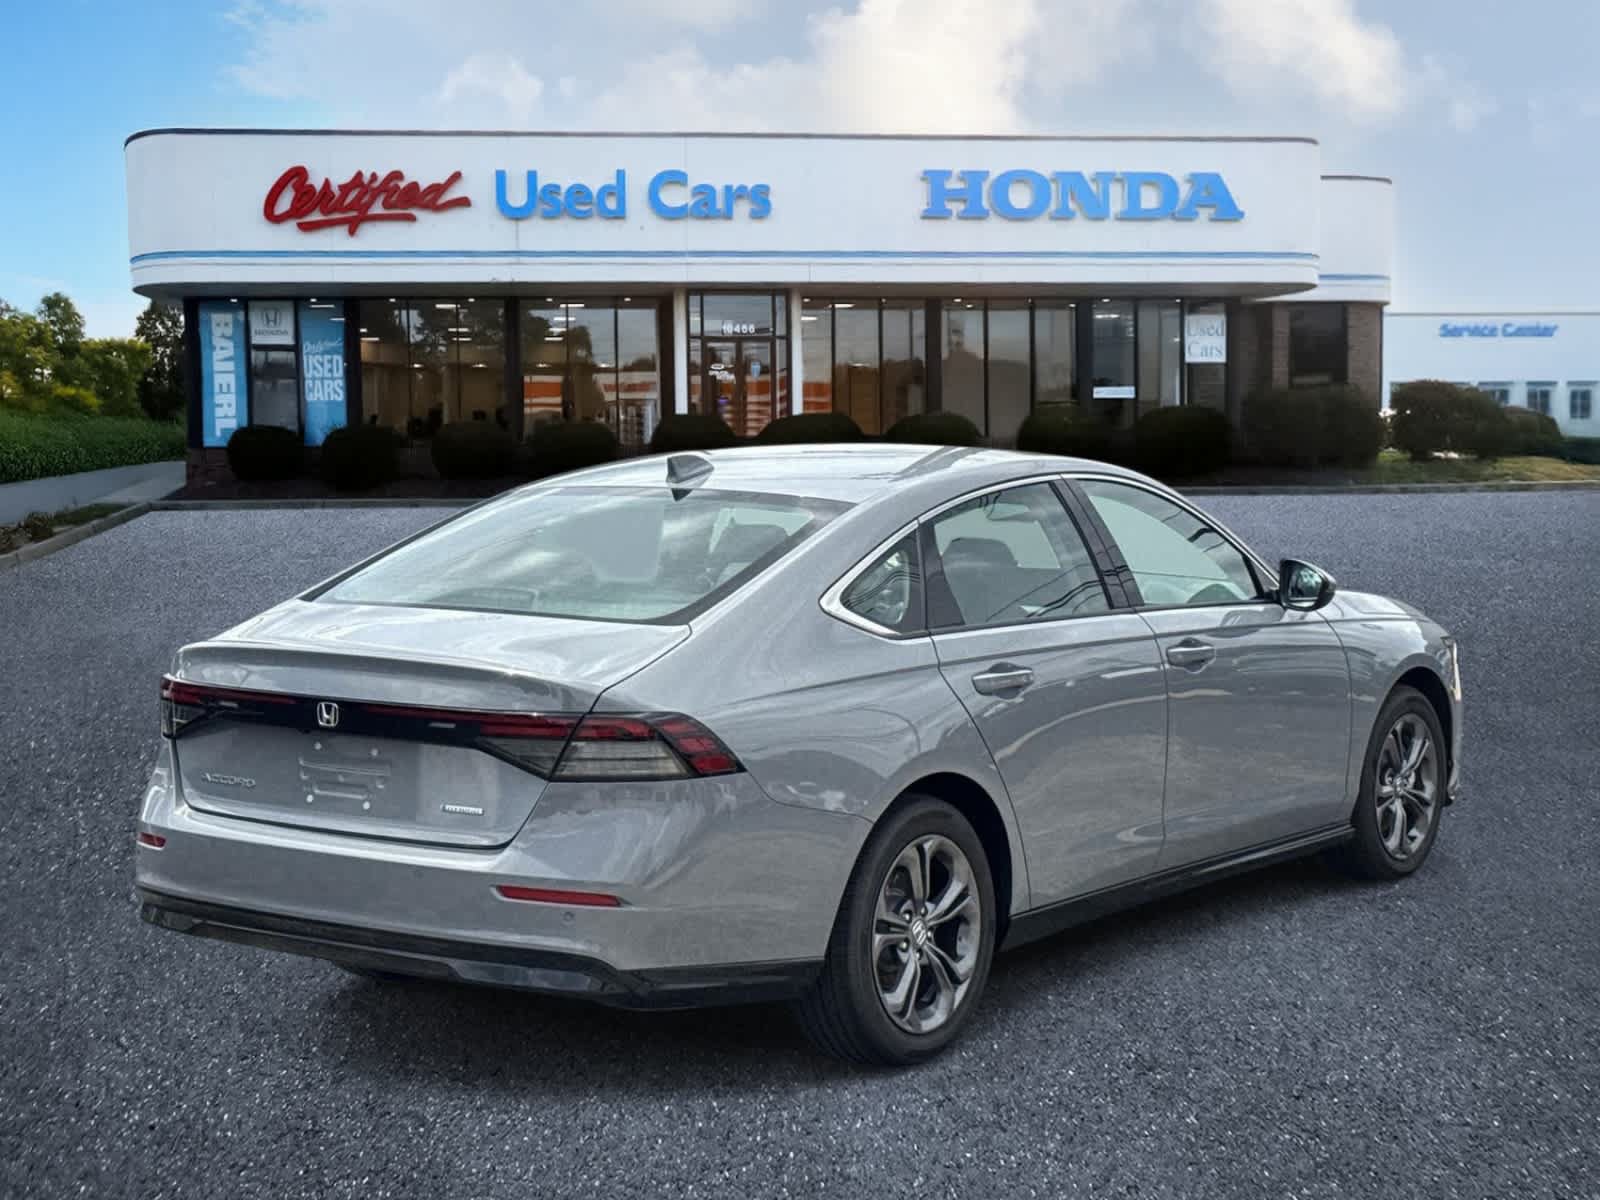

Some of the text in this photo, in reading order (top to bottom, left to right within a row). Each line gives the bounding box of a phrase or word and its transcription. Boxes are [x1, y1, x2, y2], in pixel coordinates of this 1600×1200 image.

[264, 166, 773, 236] Certified Used Cars
[920, 169, 1245, 221] HONDA
[1187, 318, 1224, 336] Used
[1187, 341, 1224, 358] Cars
[211, 313, 237, 436] BAIERL
[303, 354, 343, 378] USED
[304, 379, 344, 401] CARS
